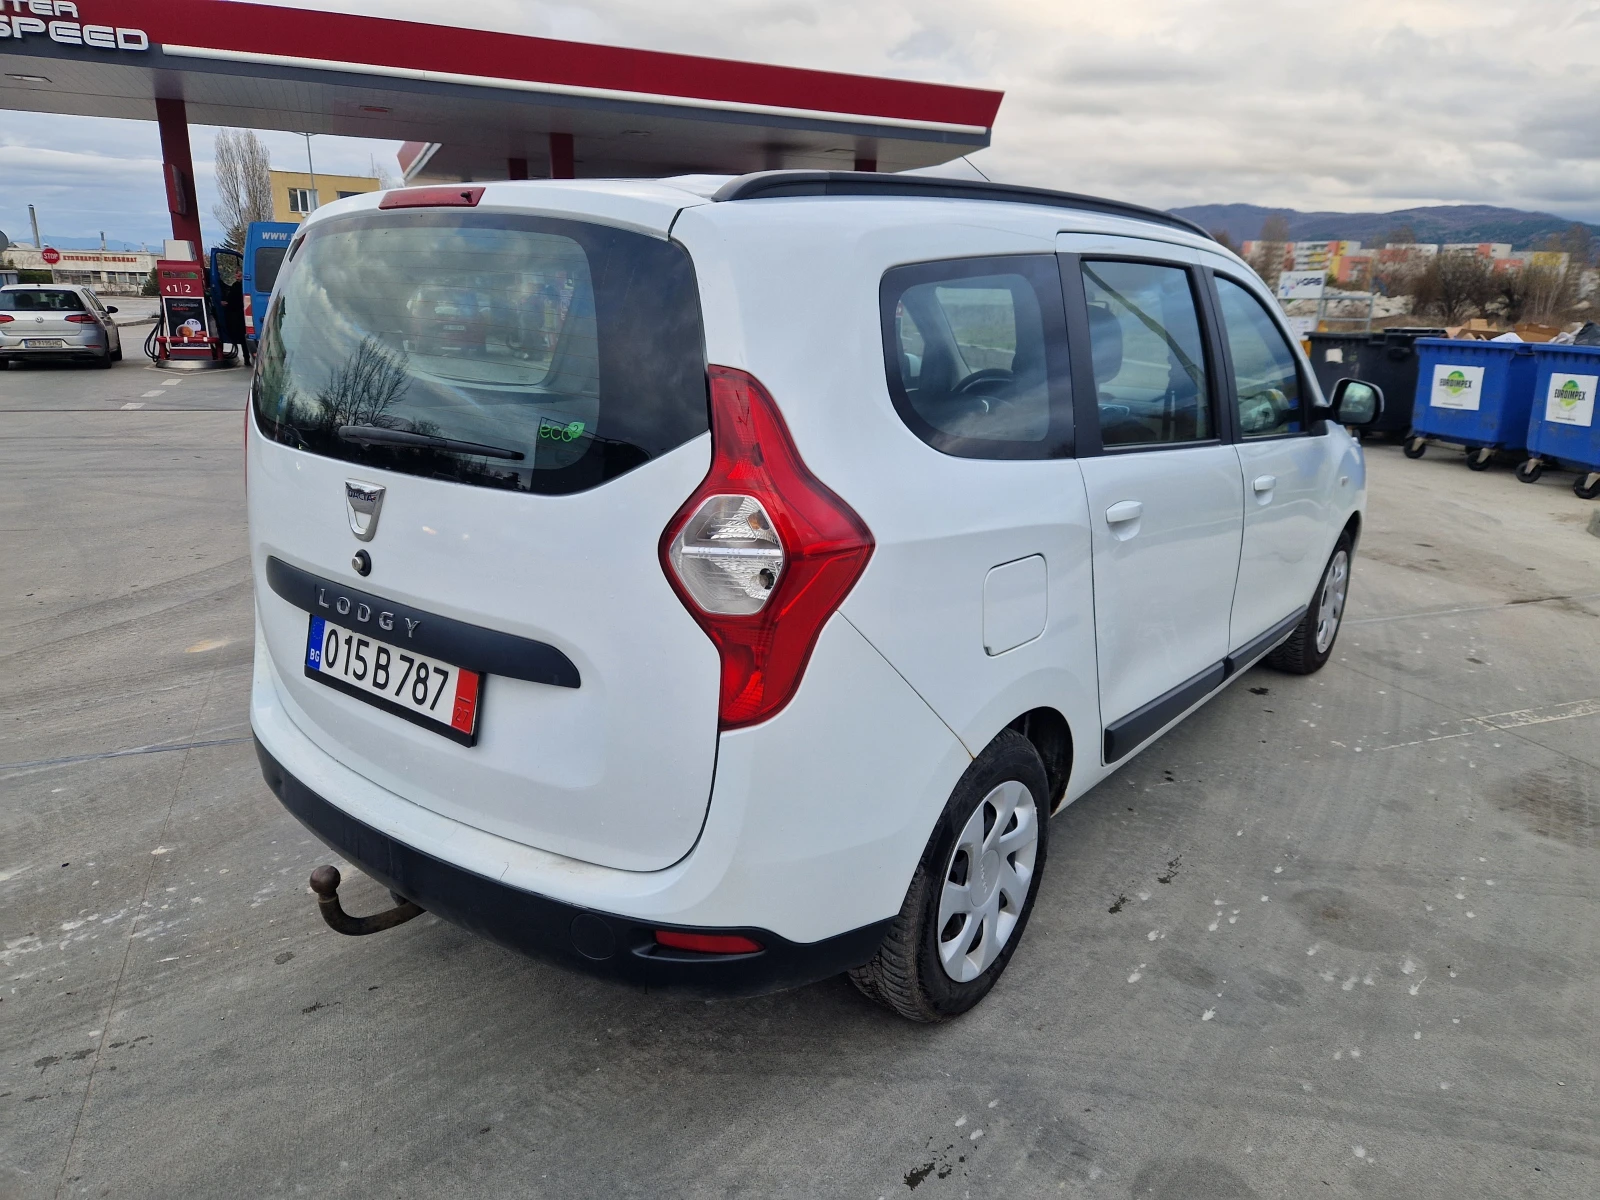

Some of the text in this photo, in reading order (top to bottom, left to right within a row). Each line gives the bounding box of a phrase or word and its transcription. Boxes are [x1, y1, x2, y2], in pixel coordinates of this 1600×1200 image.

[43, 252, 59, 260] STOP
[184, 284, 191, 293] 2
[1439, 378, 1473, 389] EUROIMPEX
[1554, 388, 1587, 401] EUROIMPEX
[348, 489, 374, 502] DACIA
[318, 588, 421, 638] LODGY
[309, 648, 320, 662] BG
[324, 628, 449, 711] 015B787
[455, 706, 470, 725] 27
